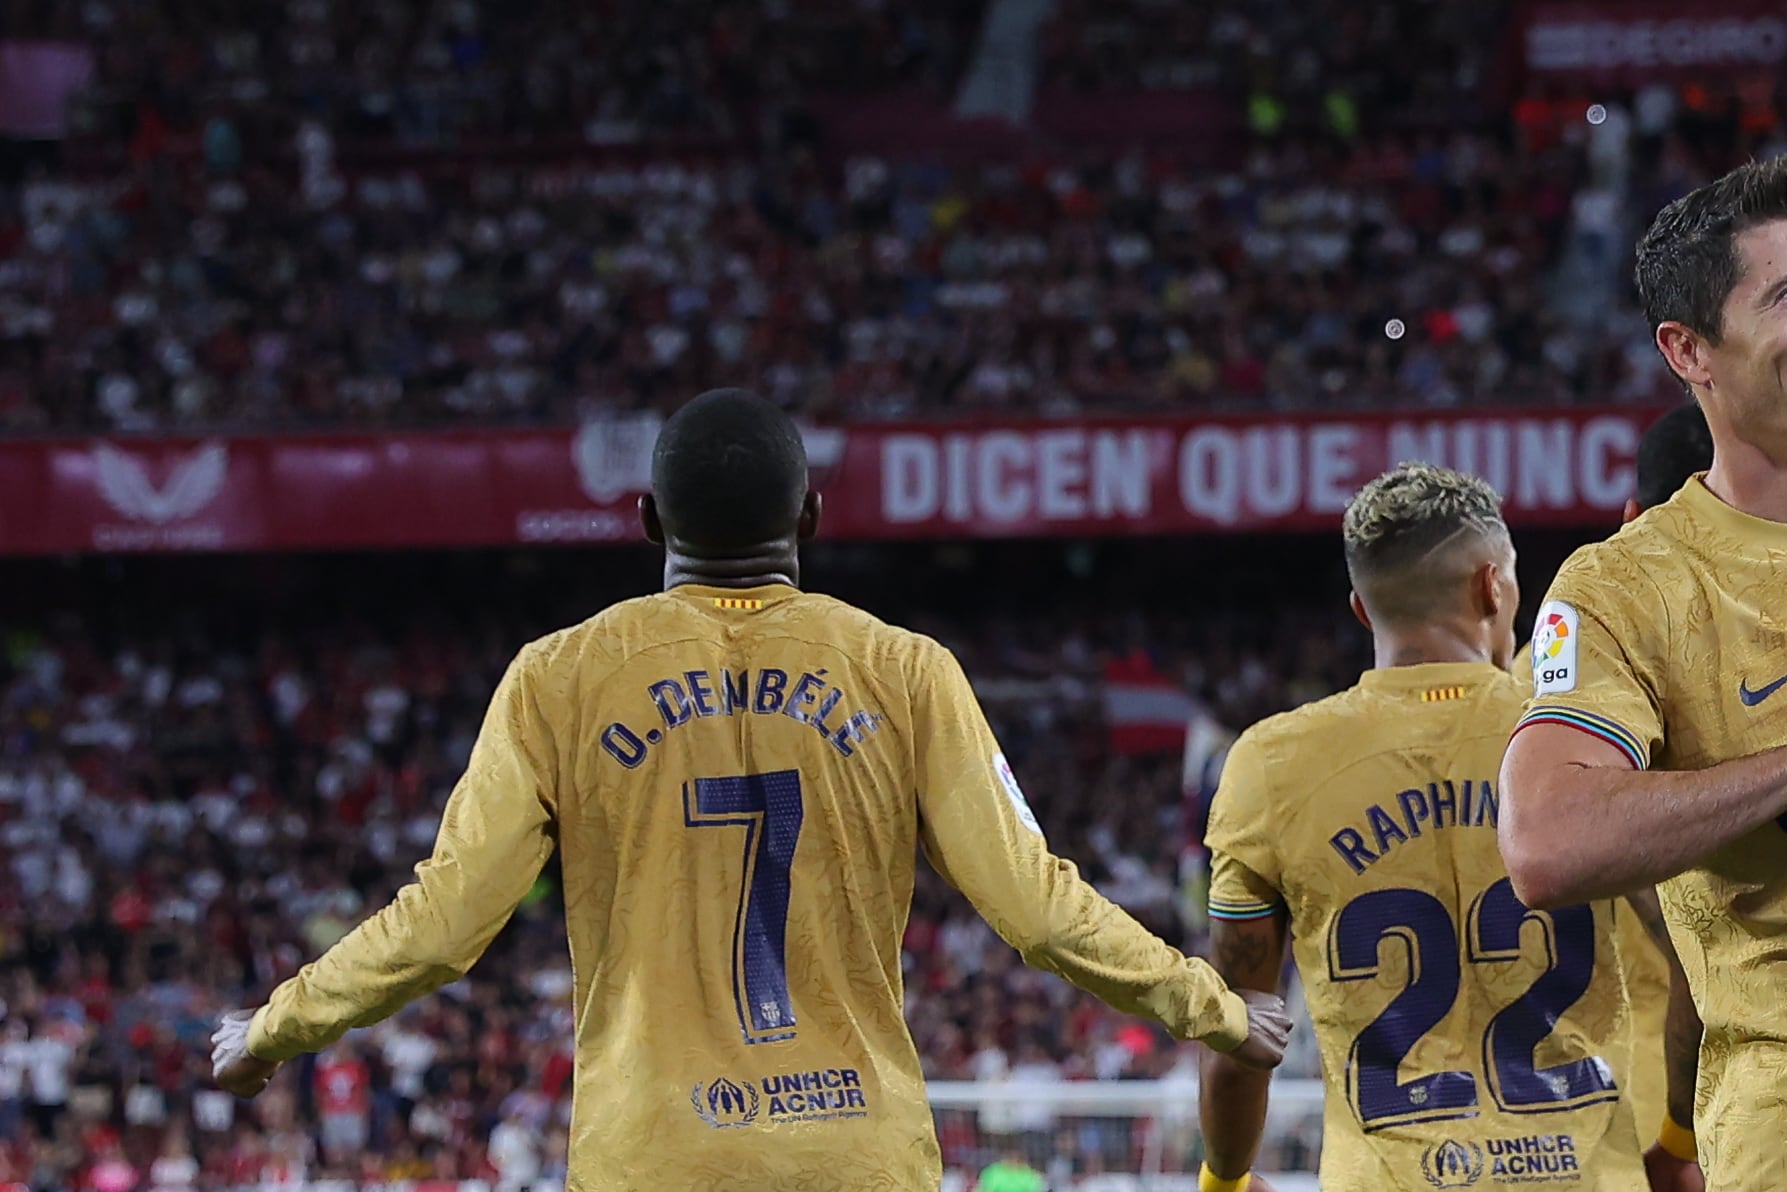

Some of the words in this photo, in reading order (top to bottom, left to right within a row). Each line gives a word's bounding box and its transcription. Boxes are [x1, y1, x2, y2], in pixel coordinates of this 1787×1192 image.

[877, 430, 1154, 523] DICEN
[1178, 422, 1359, 525] QUE
[1387, 417, 1638, 508] NUNC
[1329, 780, 1499, 876] RAPHIN
[682, 768, 804, 1045] 7
[1326, 876, 1619, 1133] 22
[762, 1069, 861, 1095] UNHCR
[768, 1088, 867, 1116] ACNUR
[1486, 1135, 1576, 1156] UNHCR
[1491, 1154, 1579, 1176] ACNUR
